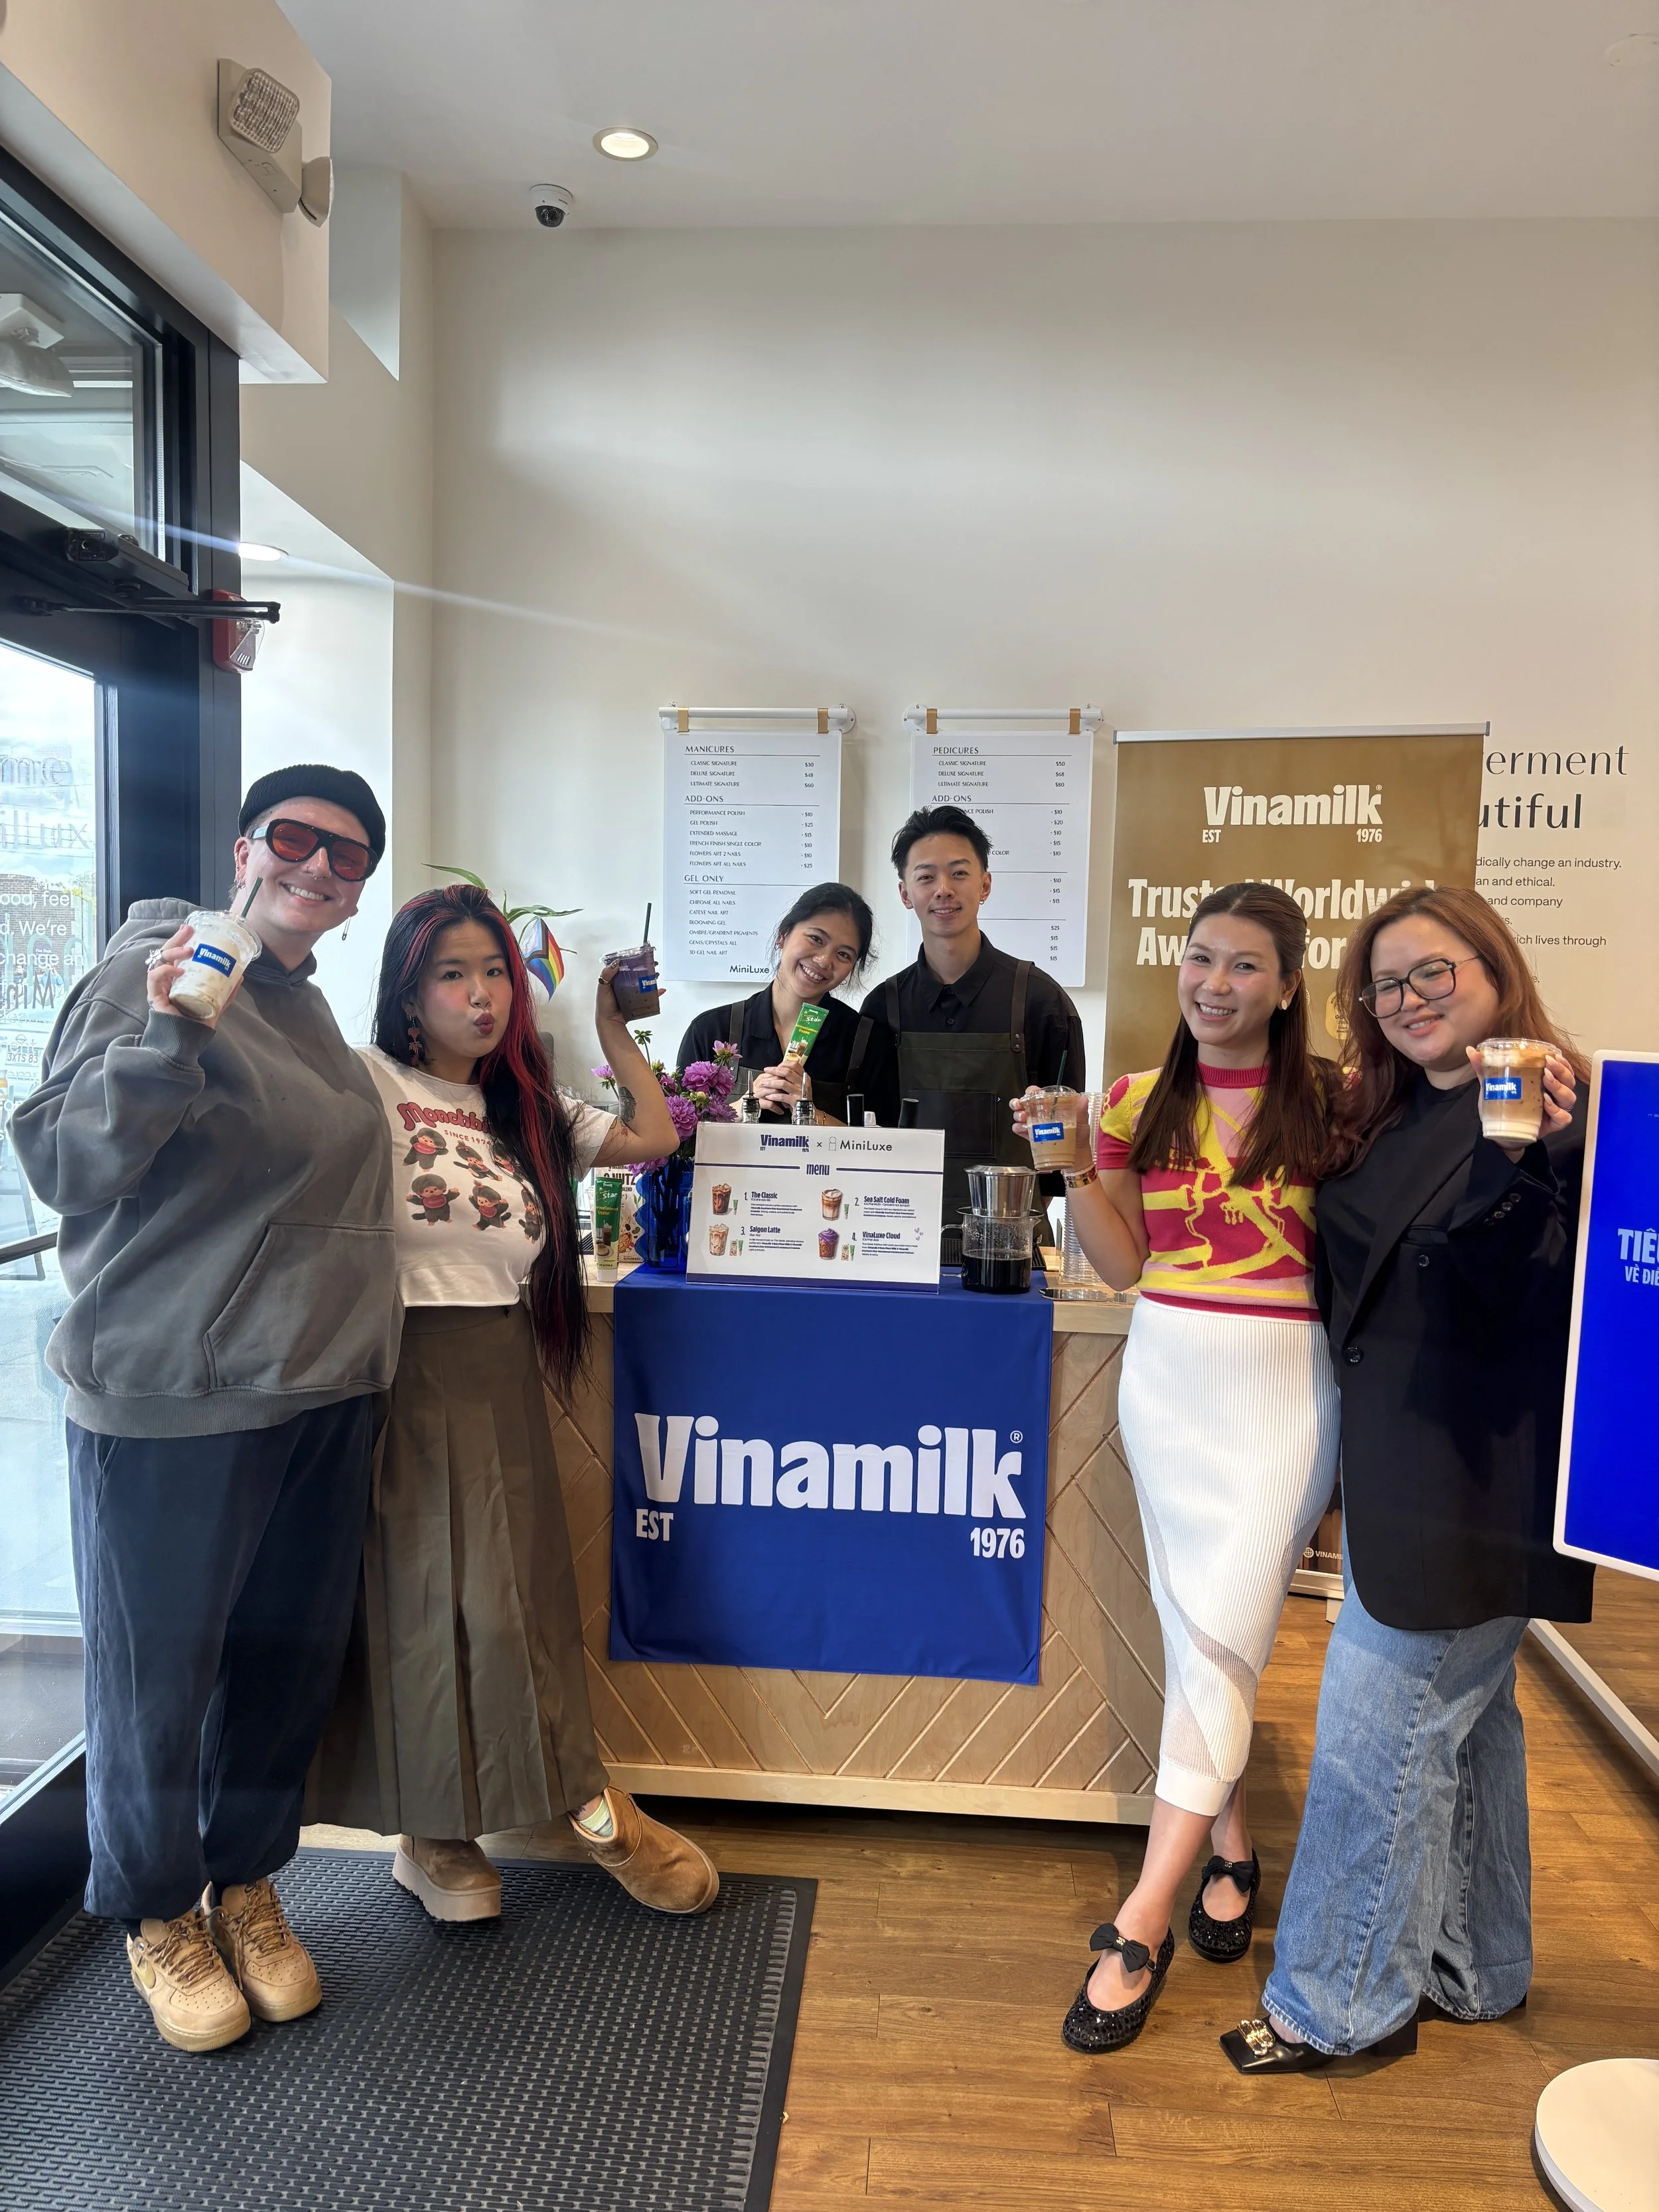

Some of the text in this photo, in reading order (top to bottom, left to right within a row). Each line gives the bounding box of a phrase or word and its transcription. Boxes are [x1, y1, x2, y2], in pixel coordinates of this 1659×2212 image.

[1486, 745, 1629, 775] erment
[1202, 829, 1221, 843] EST
[1356, 828, 1382, 843] 1976
[1513, 857, 1555, 869] change
[1574, 857, 1622, 869] industry.
[1492, 876, 1512, 886] and
[1515, 876, 1555, 887] ethical.
[42, 890, 73, 908] feel
[1259, 879, 1435, 920] orldw
[1487, 896, 1563, 909] and company
[1535, 934, 1560, 945] lives
[1563, 935, 1607, 948] through
[729, 965, 770, 974] MiniLuxe
[397, 1102, 495, 1137] Monchhi
[444, 1130, 469, 1142] SINCE
[760, 1134, 810, 1147] Vinamilk
[839, 1140, 893, 1151] MiniLuxe
[806, 1164, 830, 1176] menu
[1617, 1227, 1659, 1264] TIÊ
[636, 1509, 674, 1542] EST
[970, 1527, 1025, 1559] 1976
